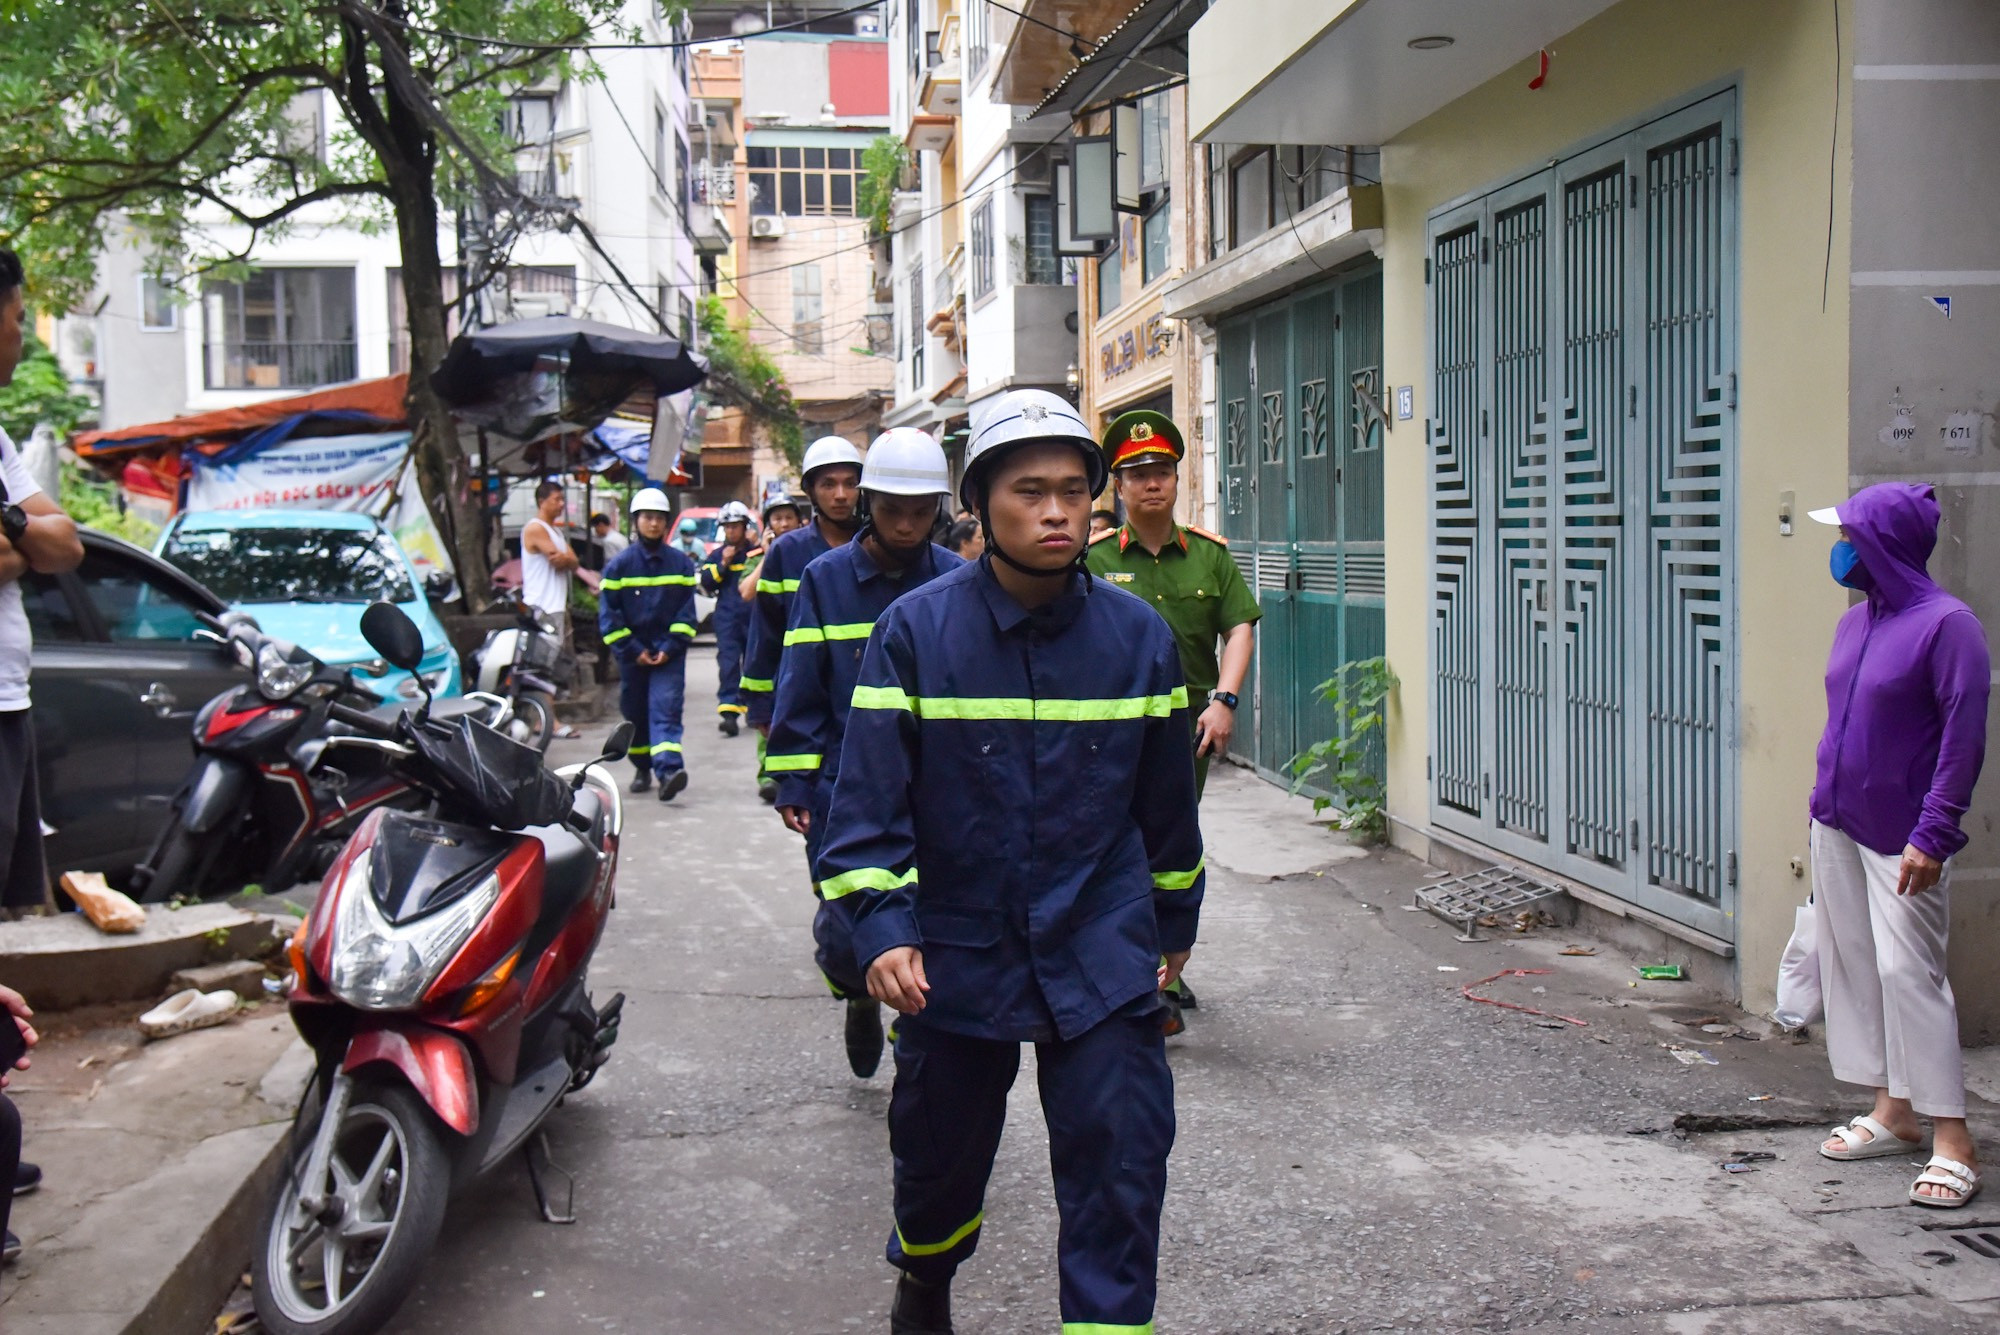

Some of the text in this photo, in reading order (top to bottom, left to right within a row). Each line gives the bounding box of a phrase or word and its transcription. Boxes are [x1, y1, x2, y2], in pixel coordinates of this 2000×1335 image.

[1400, 391, 1411, 415] 15
[1893, 428, 1914, 441] 098
[1950, 427, 1971, 440] 671
